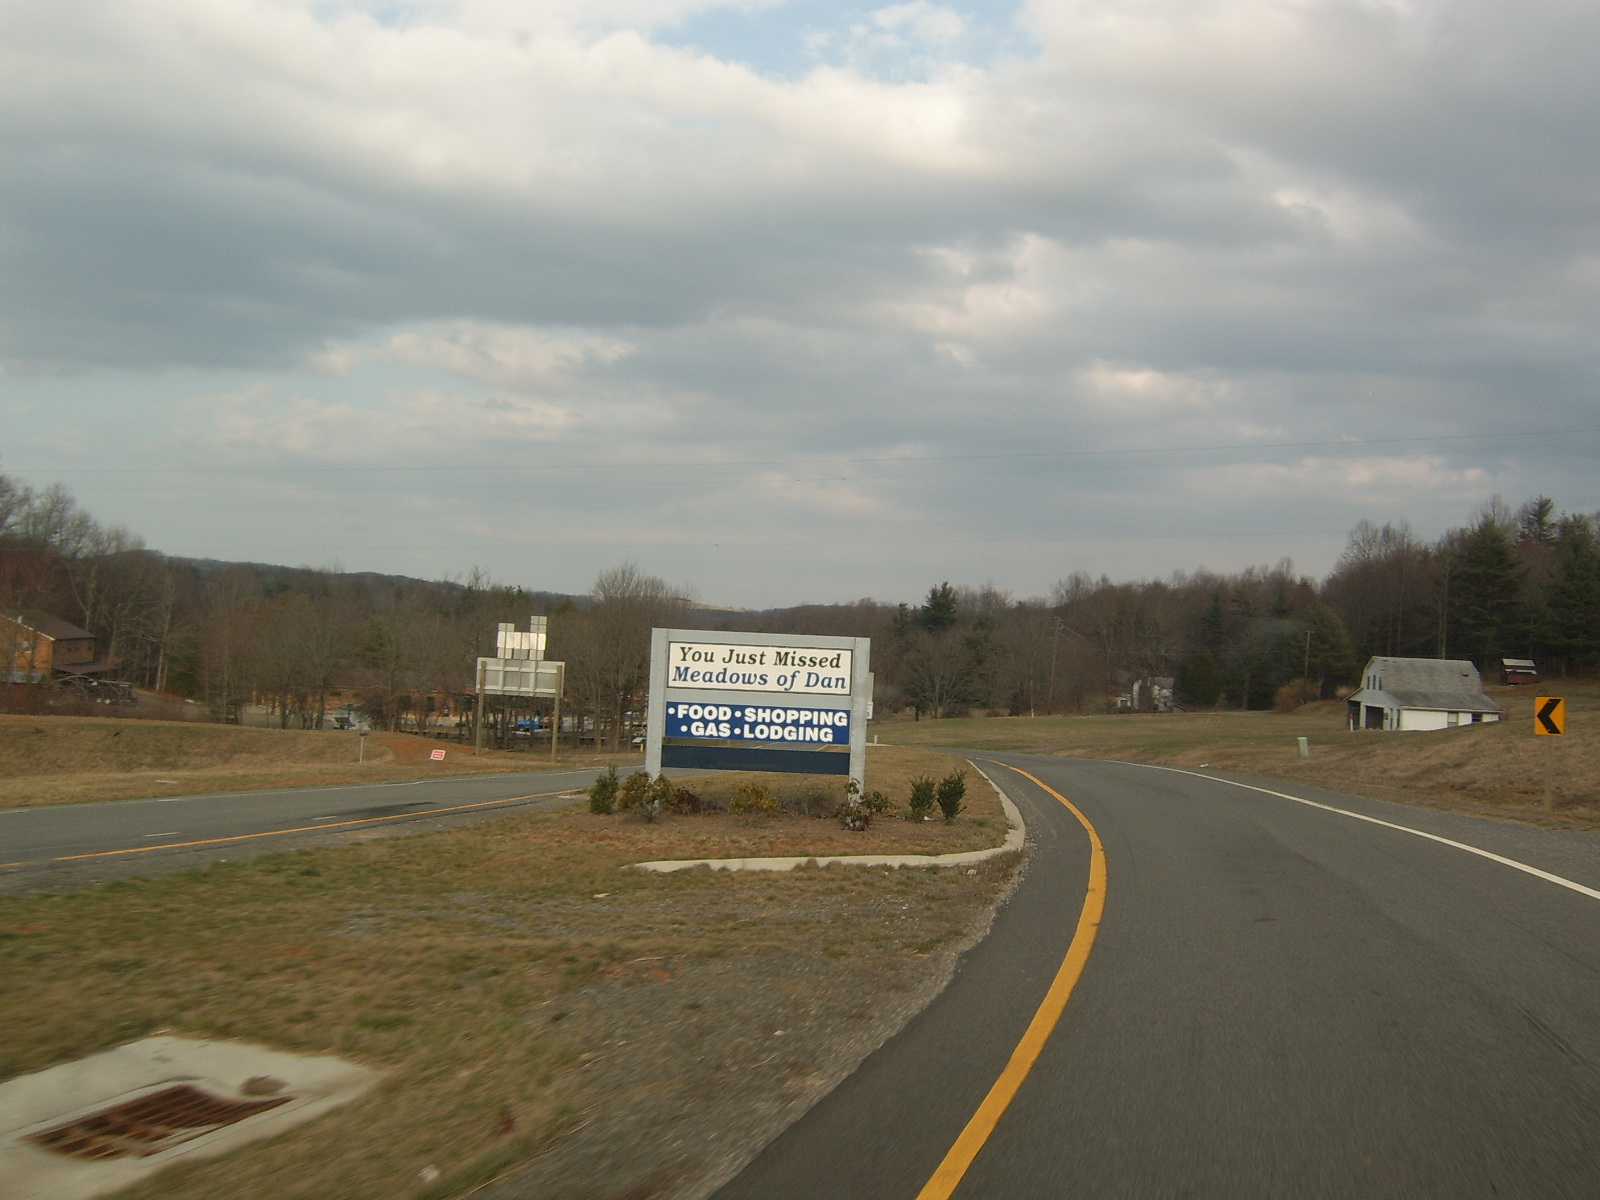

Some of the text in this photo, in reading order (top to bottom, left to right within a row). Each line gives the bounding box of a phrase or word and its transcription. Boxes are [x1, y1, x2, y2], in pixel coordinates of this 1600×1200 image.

[679, 646, 842, 668] You Just Missed
[672, 666, 847, 691] Meadows of Dan
[677, 704, 732, 721] FOOD
[744, 707, 848, 727] SHOPPING
[690, 721, 834, 742] GAS LODGING
